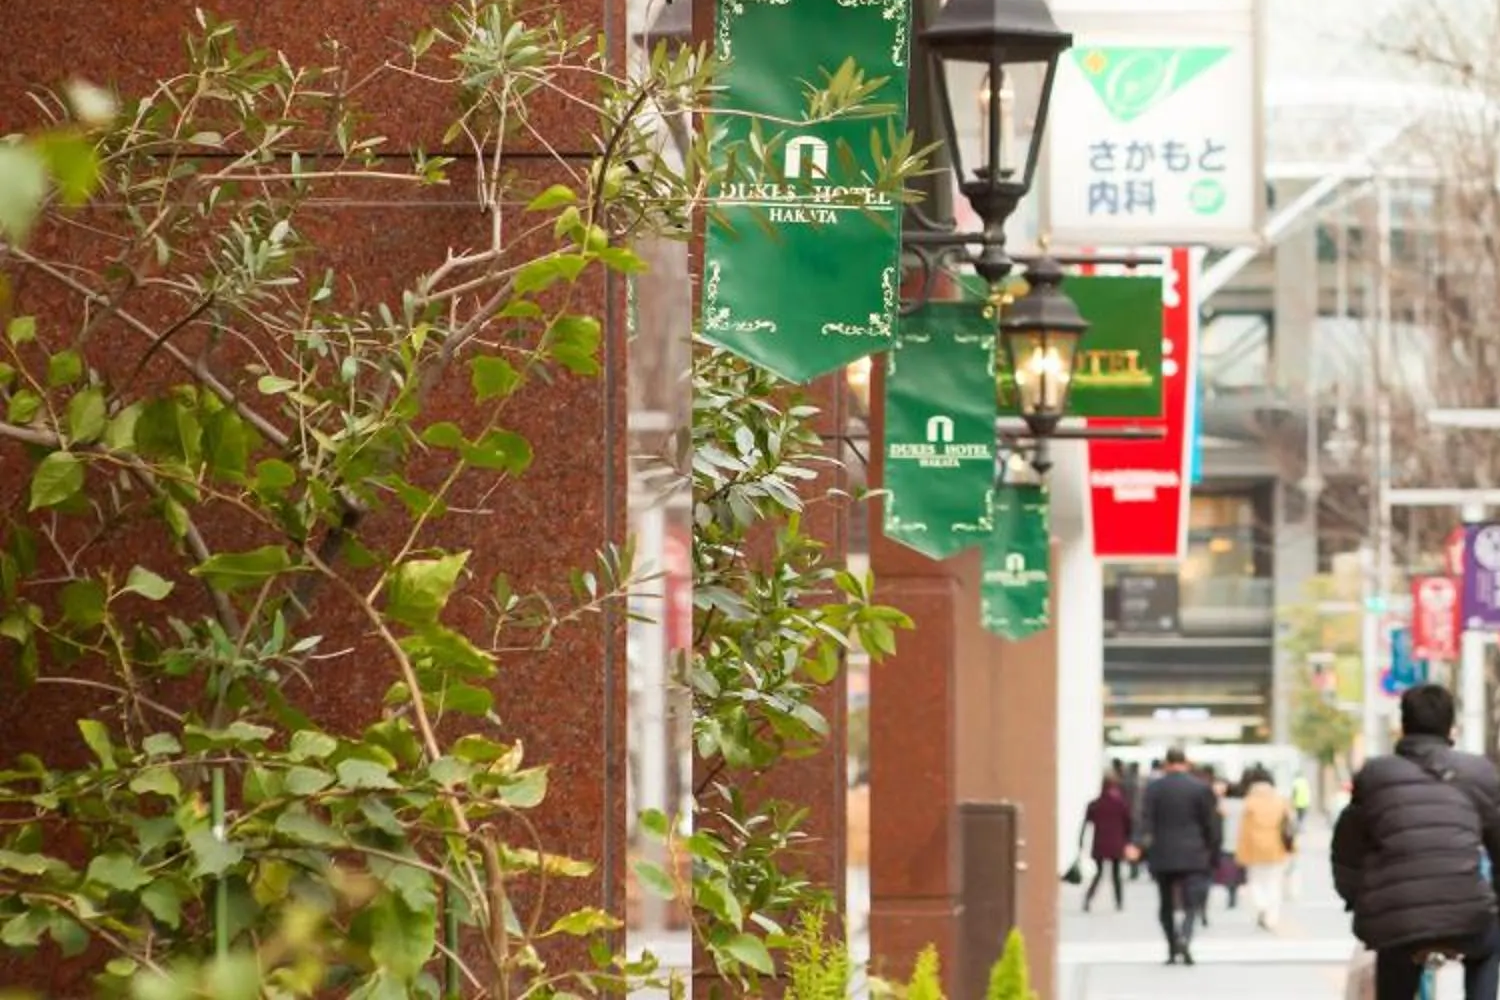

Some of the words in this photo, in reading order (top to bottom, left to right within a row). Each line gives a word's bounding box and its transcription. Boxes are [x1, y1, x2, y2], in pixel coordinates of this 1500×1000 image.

[1089, 138, 1227, 172] さかもと
[1088, 179, 1156, 216] 内科
